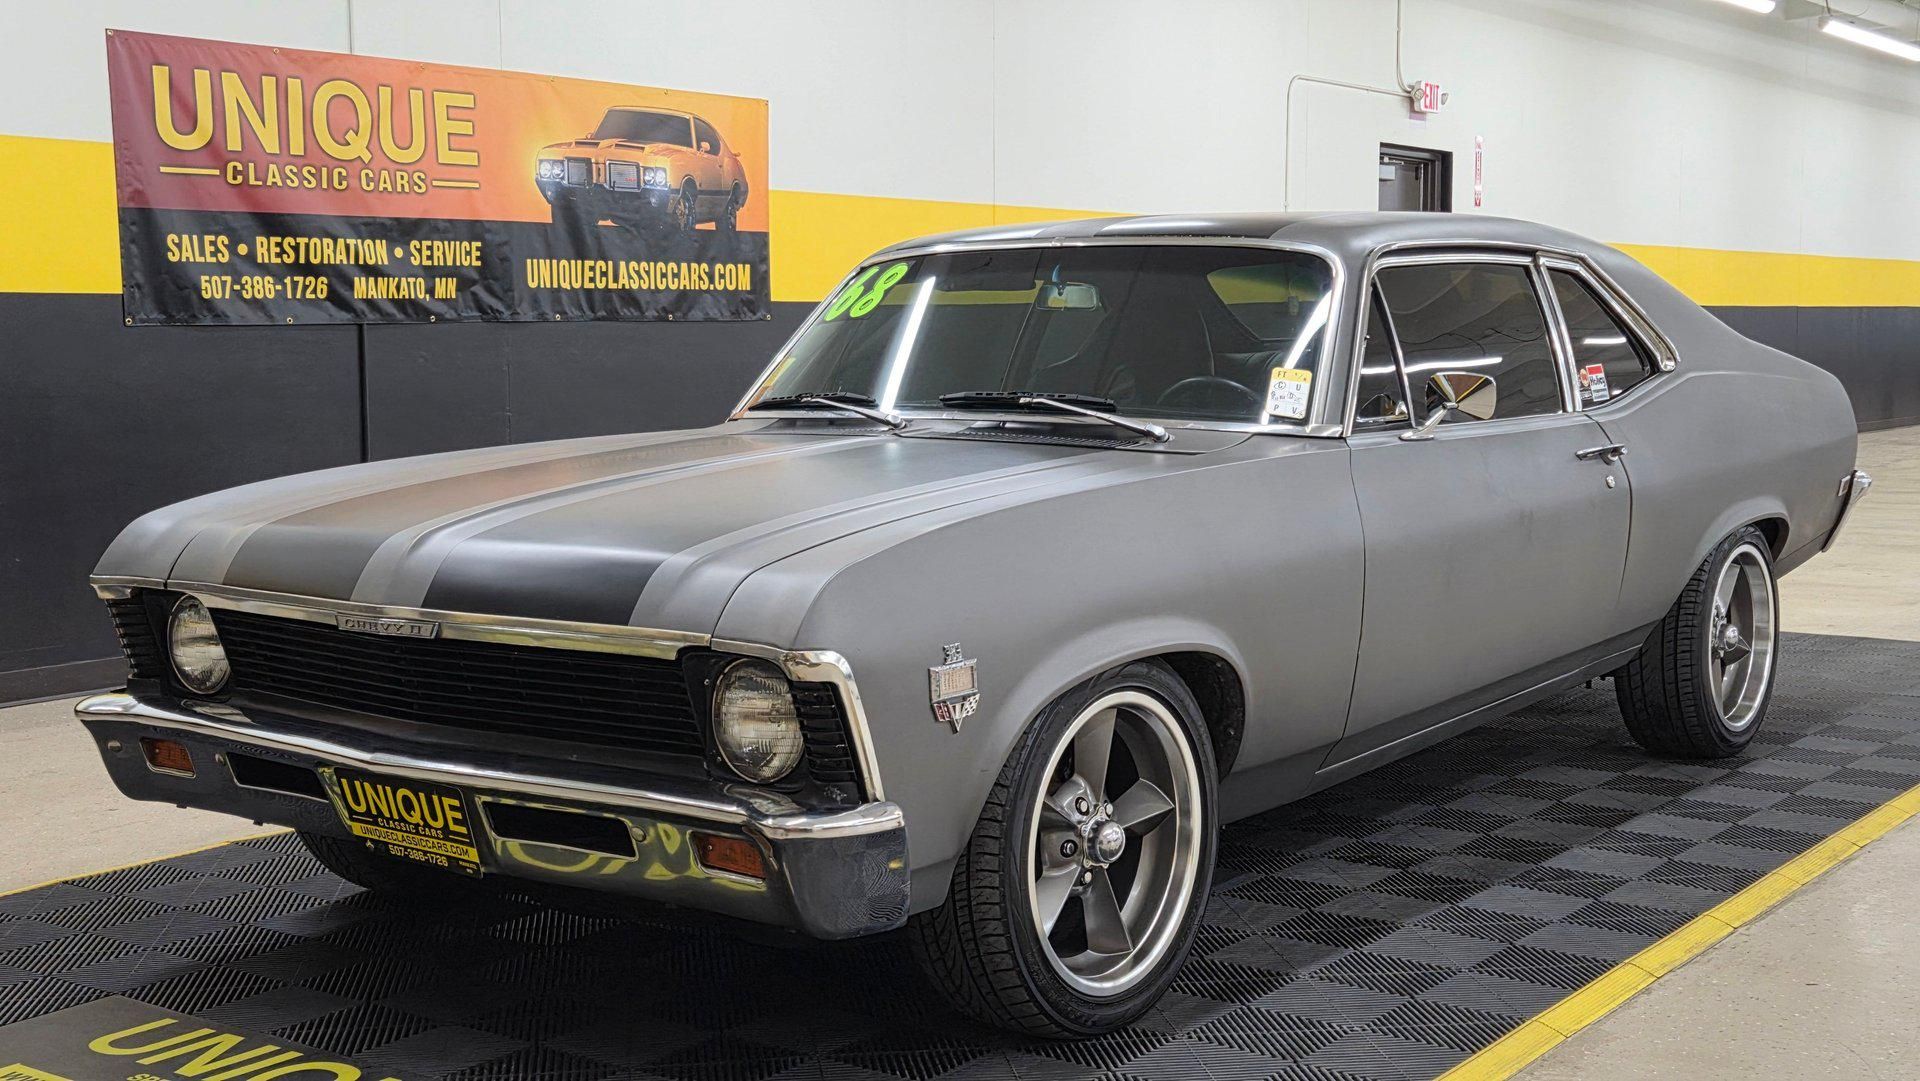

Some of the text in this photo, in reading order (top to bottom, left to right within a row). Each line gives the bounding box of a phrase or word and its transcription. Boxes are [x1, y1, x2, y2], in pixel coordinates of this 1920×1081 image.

[1424, 83, 1440, 110] EXIT
[152, 65, 479, 166] UNIQUE
[226, 161, 427, 194] CLASSIC CARS
[166, 233, 482, 267] SALES RESTORATION SERVICE
[201, 275, 457, 302] 507-386-1726 MANKATO, MN
[526, 258, 751, 291] UNIQUECLASSICCARS.COM
[824, 262, 909, 322] 68
[341, 778, 468, 834] UNIQUE
[360, 825, 470, 858] UNIQUECLASSICCARS.COM
[377, 817, 444, 839] CLASSIC CARS
